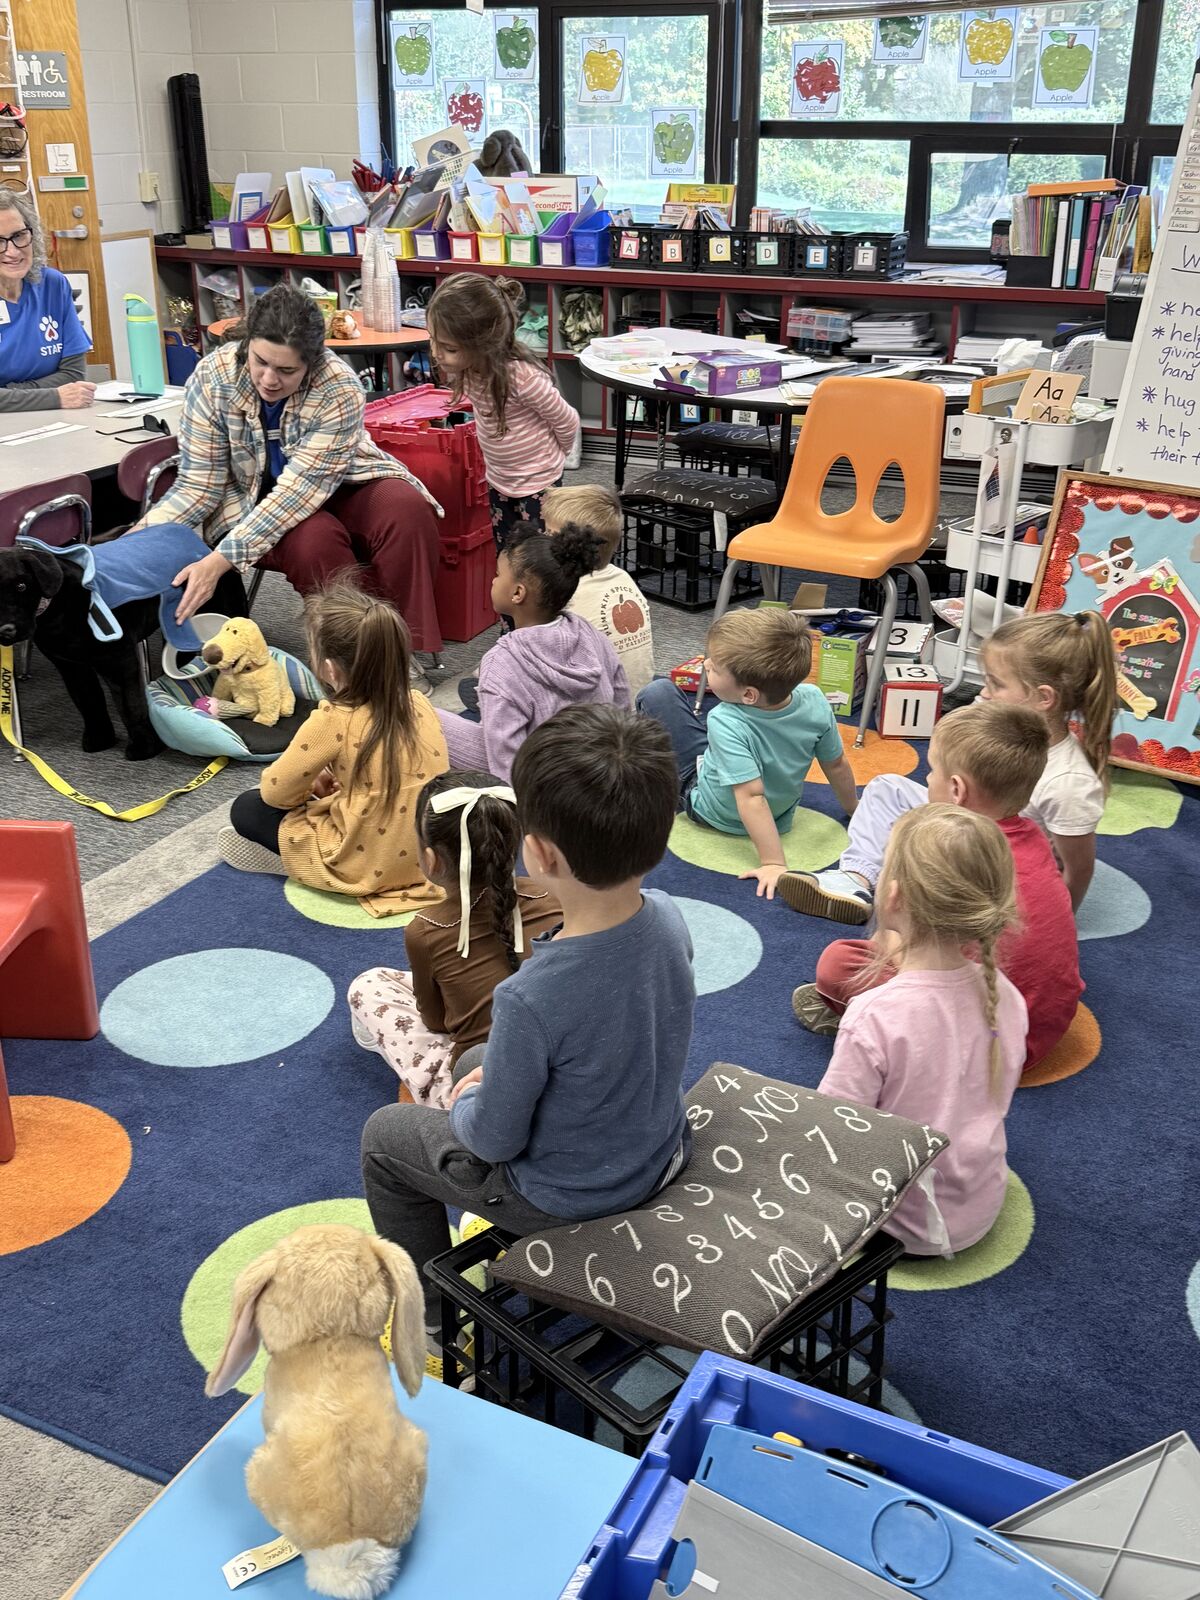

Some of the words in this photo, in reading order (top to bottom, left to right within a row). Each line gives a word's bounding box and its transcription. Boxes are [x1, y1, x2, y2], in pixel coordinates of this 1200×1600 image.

[888, 50, 909, 58] Apple
[21, 90, 66, 98] RESTROOM
[1050, 94, 1073, 102] Apple
[663, 166, 683, 174] Apple
[535, 201, 556, 209] econd
[625, 243, 633, 254] A
[669, 248, 677, 258] B
[716, 244, 723, 254] C
[764, 248, 772, 258] D
[814, 252, 820, 262] E
[862, 252, 868, 262] F
[1162, 361, 1195, 381] hand
[1034, 377, 1063, 401] Aa
[1164, 387, 1196, 416] hug
[687, 407, 694, 416] K
[1039, 405, 1060, 423] Aa
[1157, 413, 1192, 446] help
[1150, 446, 1188, 465] their
[1122, 607, 1137, 620] The
[889, 628, 908, 646] 3
[1134, 629, 1152, 642] FALL
[1128, 656, 1165, 670] weather
[895, 666, 929, 679] 13
[1, 668, 12, 701] ADOPT
[1117, 679, 1141, 701] UNNY
[1, 702, 11, 715] ME
[901, 699, 920, 727] 11
[713, 1074, 741, 1093] 4
[652, 1262, 692, 1313] 2
[686, 1233, 723, 1265] 3
[723, 1213, 757, 1241] 4
[753, 1187, 785, 1221] 5
[779, 1153, 811, 1195] 6
[804, 1125, 839, 1165] 7
[833, 1105, 871, 1133] 8
[585, 1252, 616, 1307] 6
[611, 1219, 643, 1252] 7
[683, 1183, 714, 1207] 9
[713, 1145, 743, 1173] 0
[526, 1239, 554, 1277] 0
